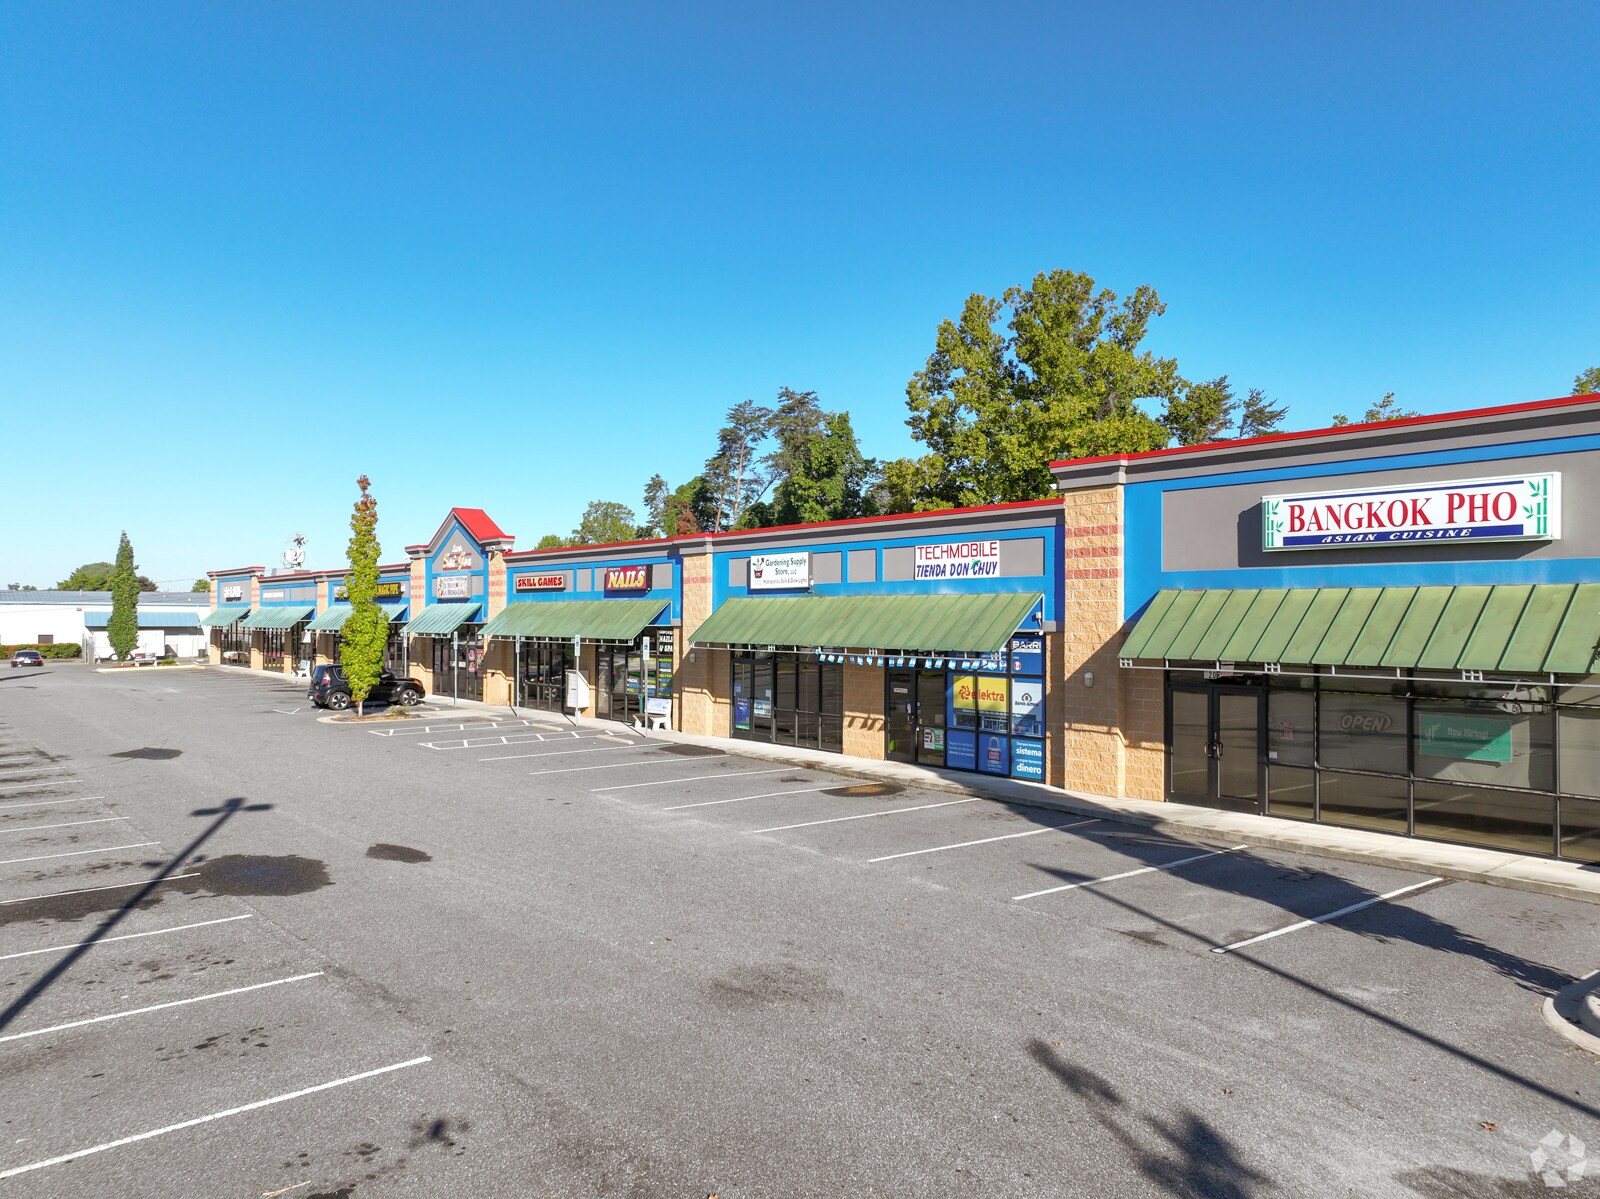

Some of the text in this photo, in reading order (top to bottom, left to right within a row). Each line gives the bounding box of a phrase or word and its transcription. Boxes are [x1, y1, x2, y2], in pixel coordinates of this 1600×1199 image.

[1287, 491, 1518, 533] BANGKOK PHO
[1321, 528, 1473, 543] ASIAN CUISINE
[916, 541, 998, 560] TECHMOBILE
[765, 556, 806, 567] Gardening Supply
[916, 561, 998, 578] TIENDA DON CHUY
[517, 576, 563, 588] SKILL GAMES
[607, 570, 646, 589] NAILS
[1012, 640, 1042, 649] BARRI
[971, 690, 1005, 702] elektra
[1340, 714, 1385, 732] OPEN
[1447, 727, 1463, 737] Now
[1016, 746, 1042, 757] sistema
[1016, 763, 1042, 775] dinero
